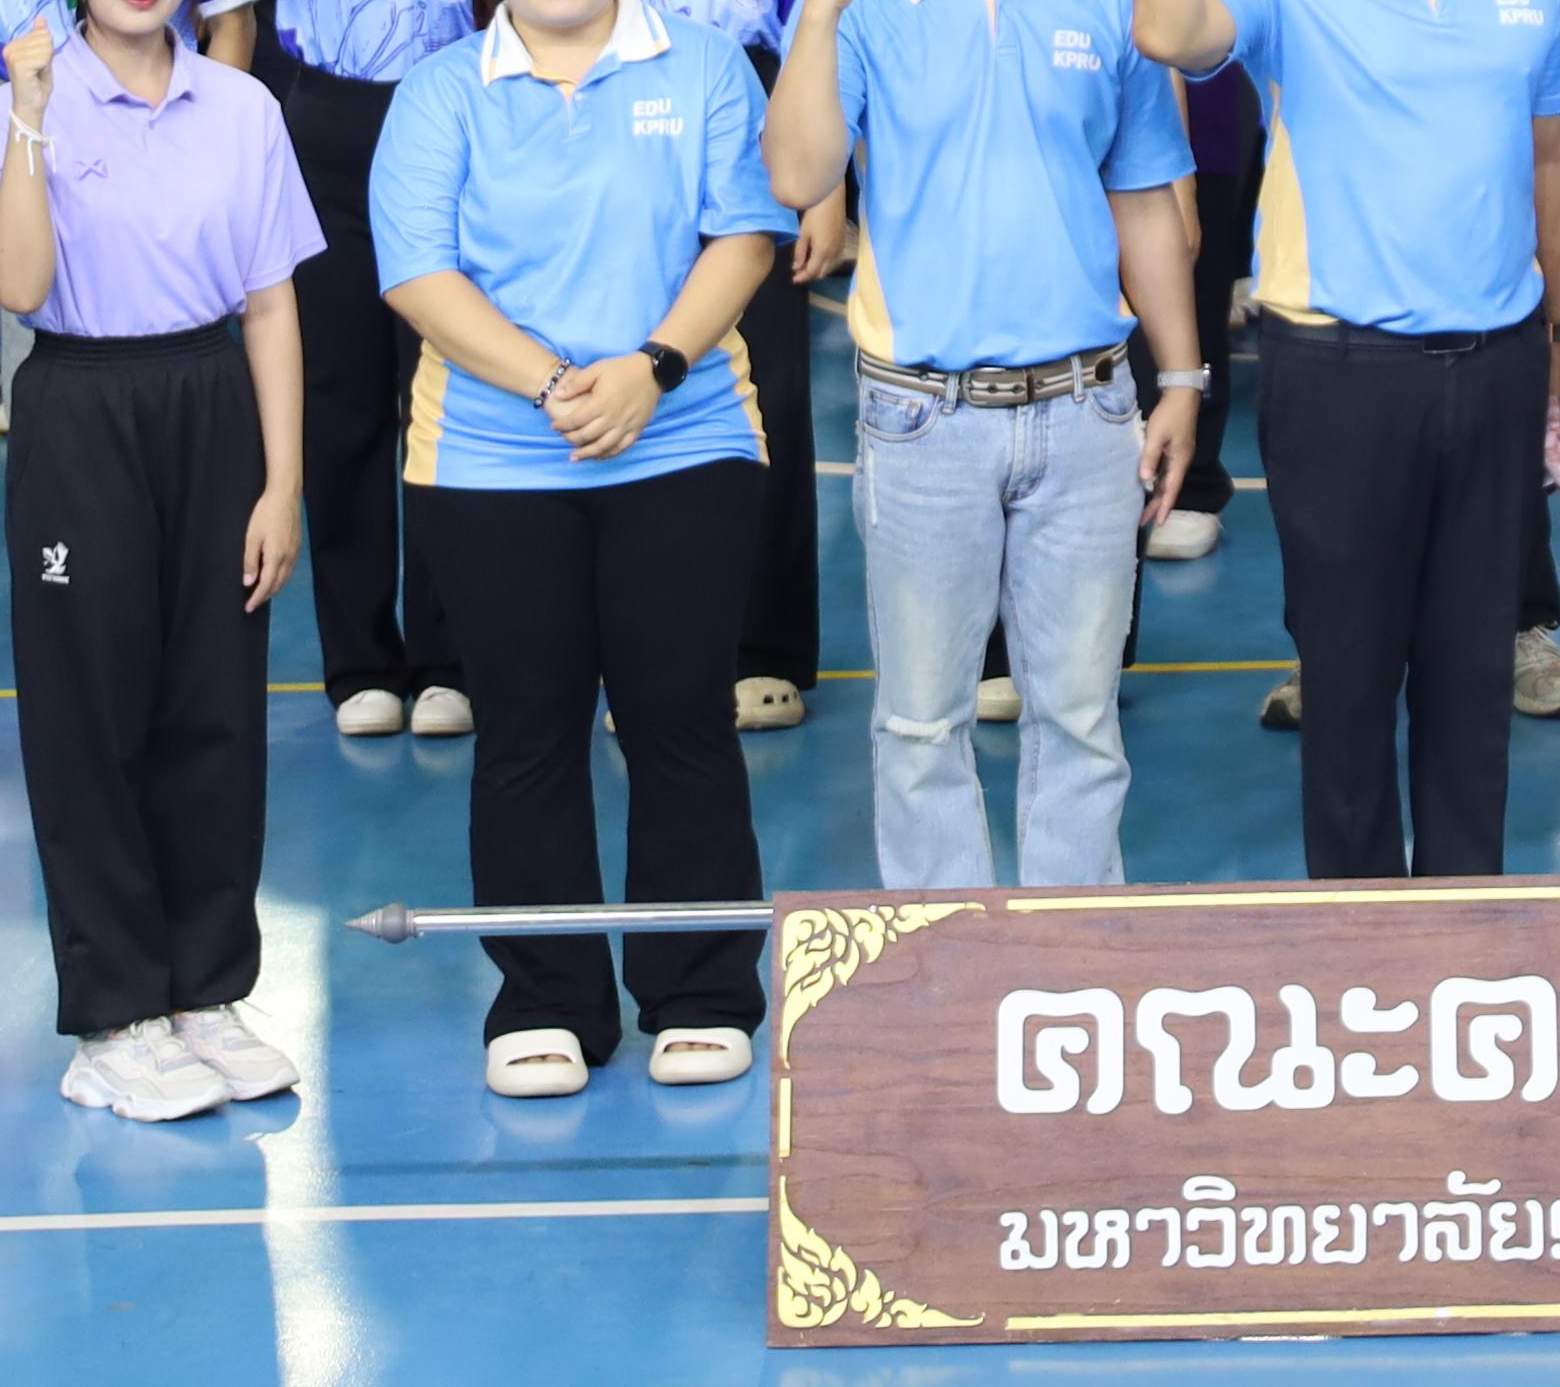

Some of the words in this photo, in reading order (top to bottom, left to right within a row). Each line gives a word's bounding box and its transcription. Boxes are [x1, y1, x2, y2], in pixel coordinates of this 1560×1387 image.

[1498, 7, 1546, 26] KPRU
[1053, 29, 1091, 49] EDU
[1051, 50, 1102, 72] KPRU
[632, 98, 672, 117] EDU
[632, 117, 684, 138] KPRU
